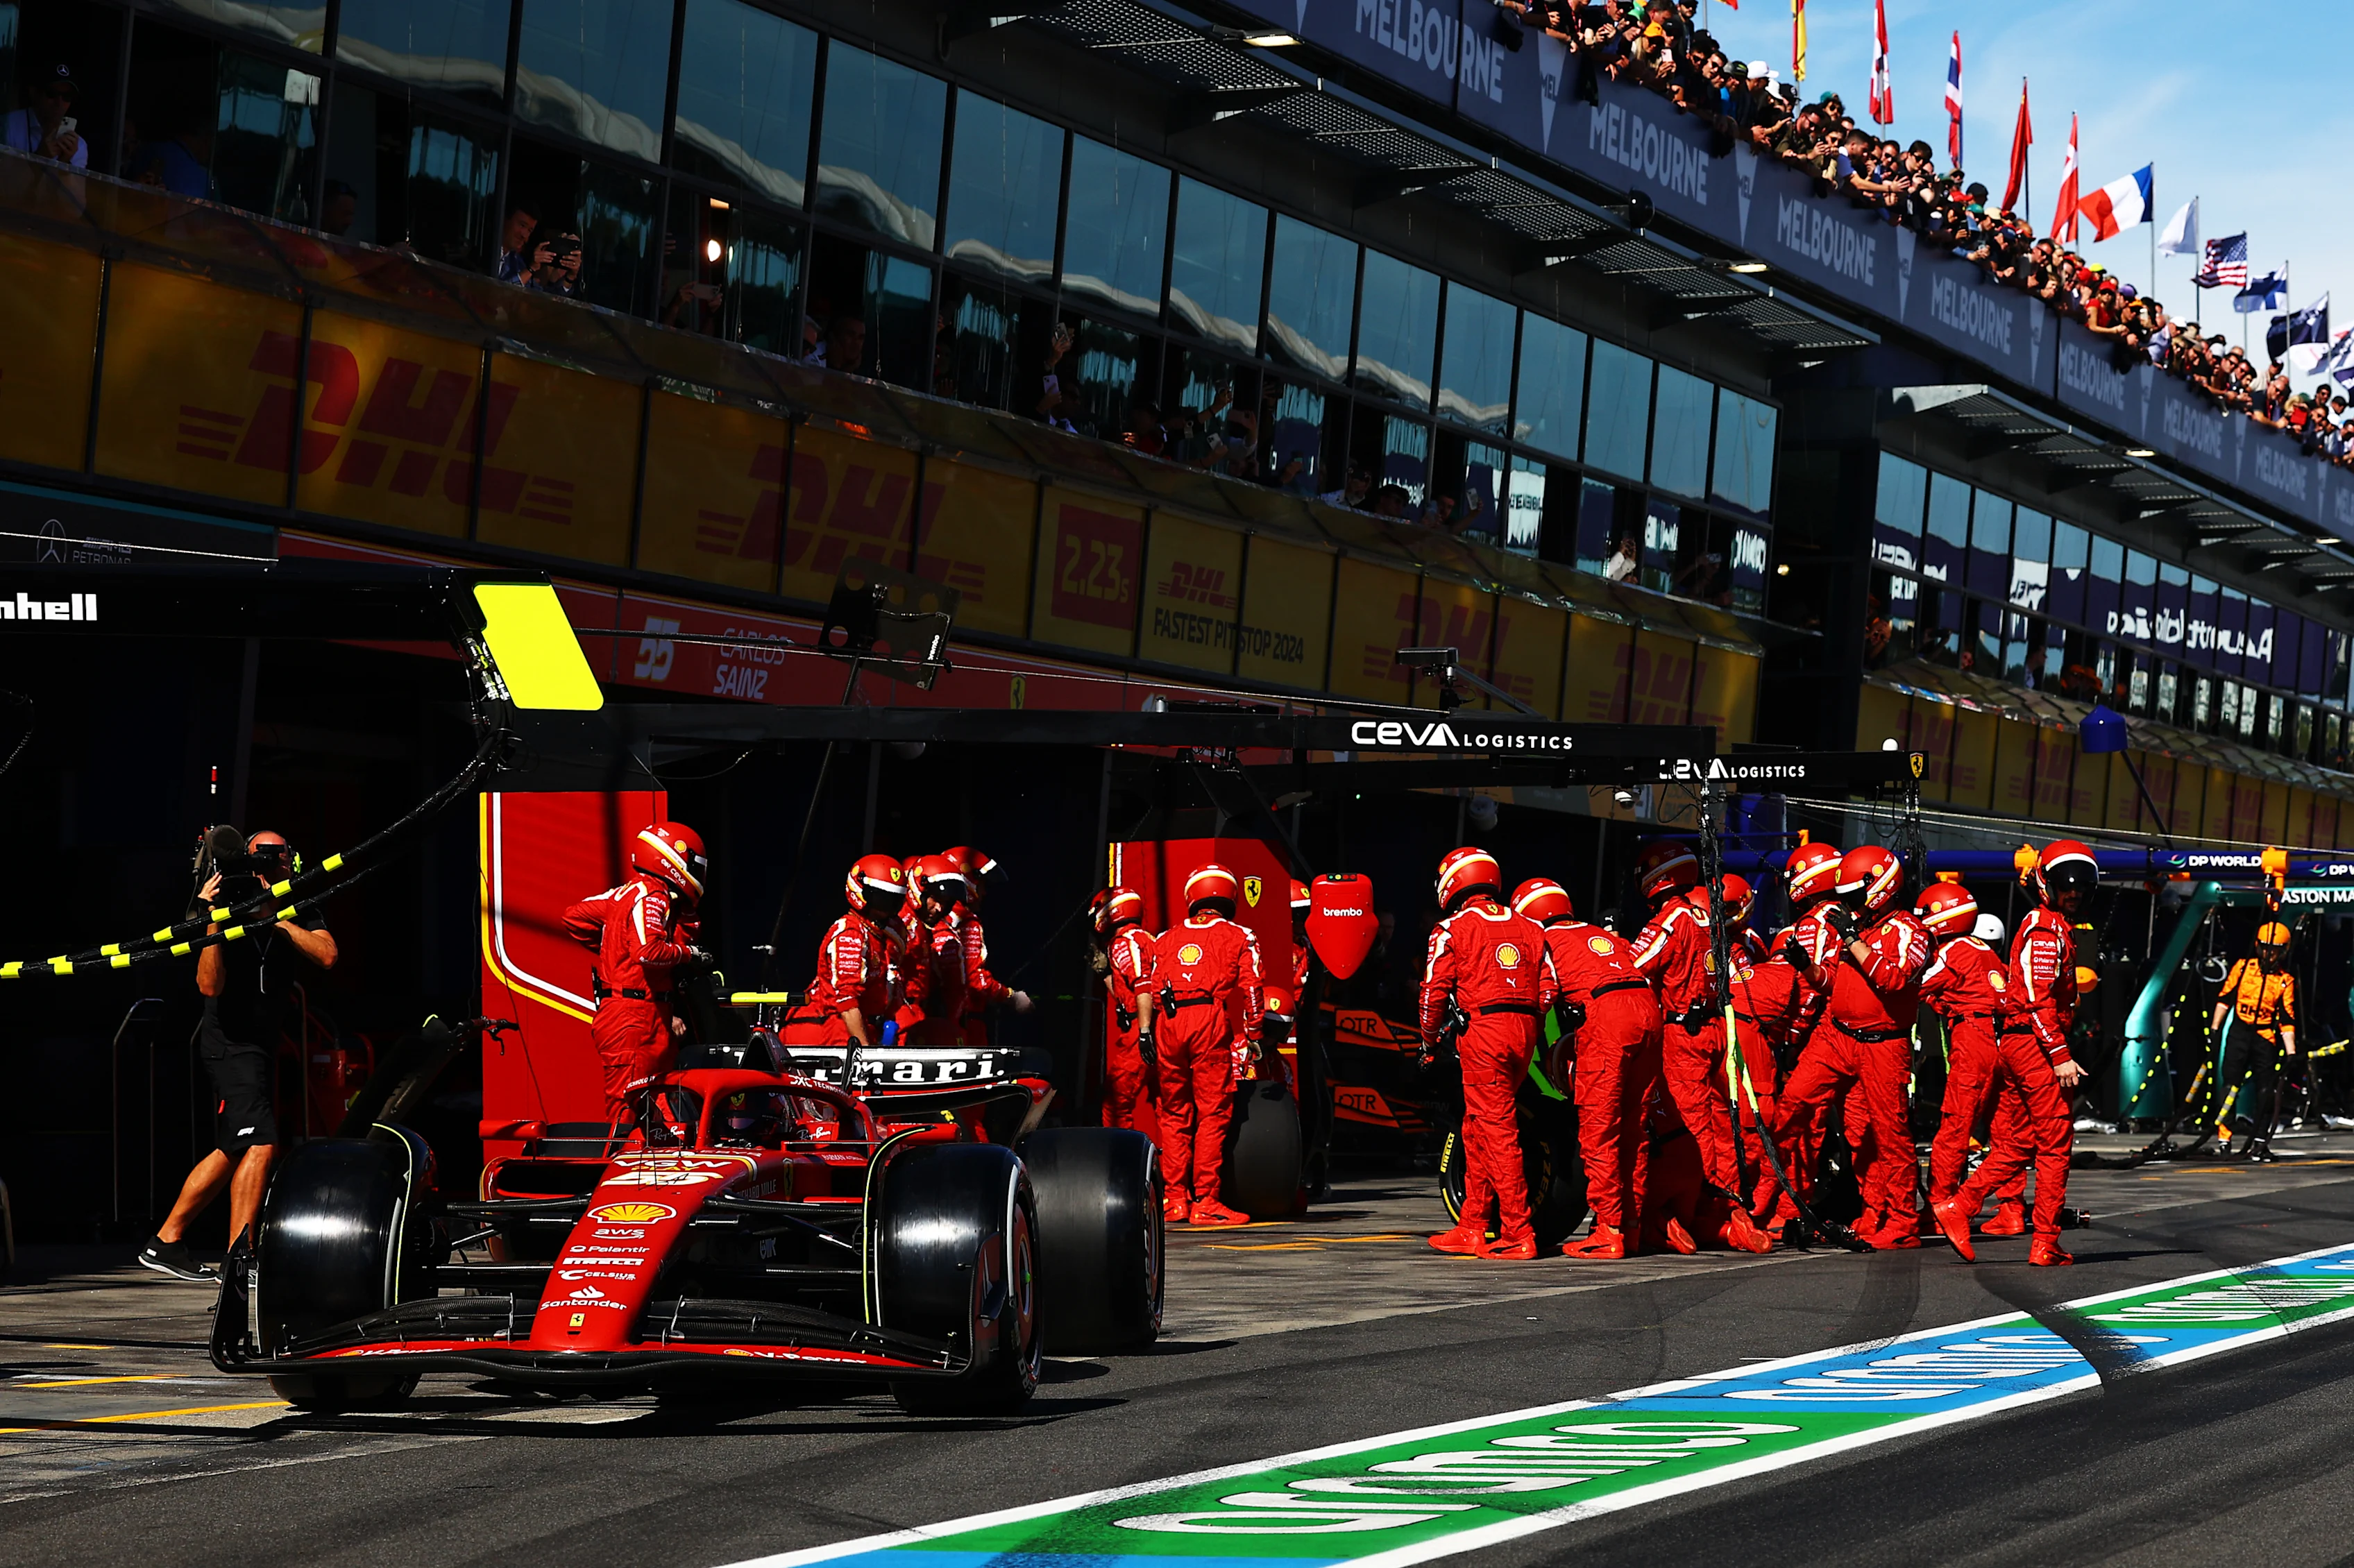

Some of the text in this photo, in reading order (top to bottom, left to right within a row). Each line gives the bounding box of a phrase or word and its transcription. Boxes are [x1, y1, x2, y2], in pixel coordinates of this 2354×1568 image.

[1355, 0, 1505, 103] MELBOURNE
[1589, 102, 1710, 206] MELBOURNE
[1777, 191, 1876, 287] MELBOURNE
[1931, 271, 2013, 356] MELBOURNE
[2059, 339, 2125, 411] MELBOURNE
[235, 330, 529, 515] DHL
[2163, 395, 2224, 459] MELBOURNE
[2255, 442, 2308, 501] MELBOURNE
[737, 444, 952, 590] DHL
[1168, 561, 1231, 607] DHL
[633, 615, 681, 683] 55
[720, 627, 789, 665] CARLOS
[1153, 607, 1304, 663] FASTEST PIT STOP 2024
[1388, 593, 1512, 699] DHL
[713, 664, 768, 701] SAINZ
[1351, 721, 1573, 750] CEVA LOGISTICS
[1731, 764, 1805, 778] LOGISTICS
[2188, 855, 2262, 867] DP WORLD
[2329, 864, 2348, 876] DP
[1323, 907, 1362, 917] brembo
[2281, 890, 2331, 904] ASTON
[1340, 1017, 1378, 1037] OTR
[788, 1074, 813, 1088] DXC
[1339, 1093, 1376, 1110] OTR
[601, 1171, 724, 1187] 55
[761, 1179, 777, 1197] MILLE
[562, 1257, 645, 1266] PIRELLI
[540, 1299, 627, 1311] Santander
[754, 1351, 867, 1364] V-Power
[1112, 1420, 1802, 1535] aramco
